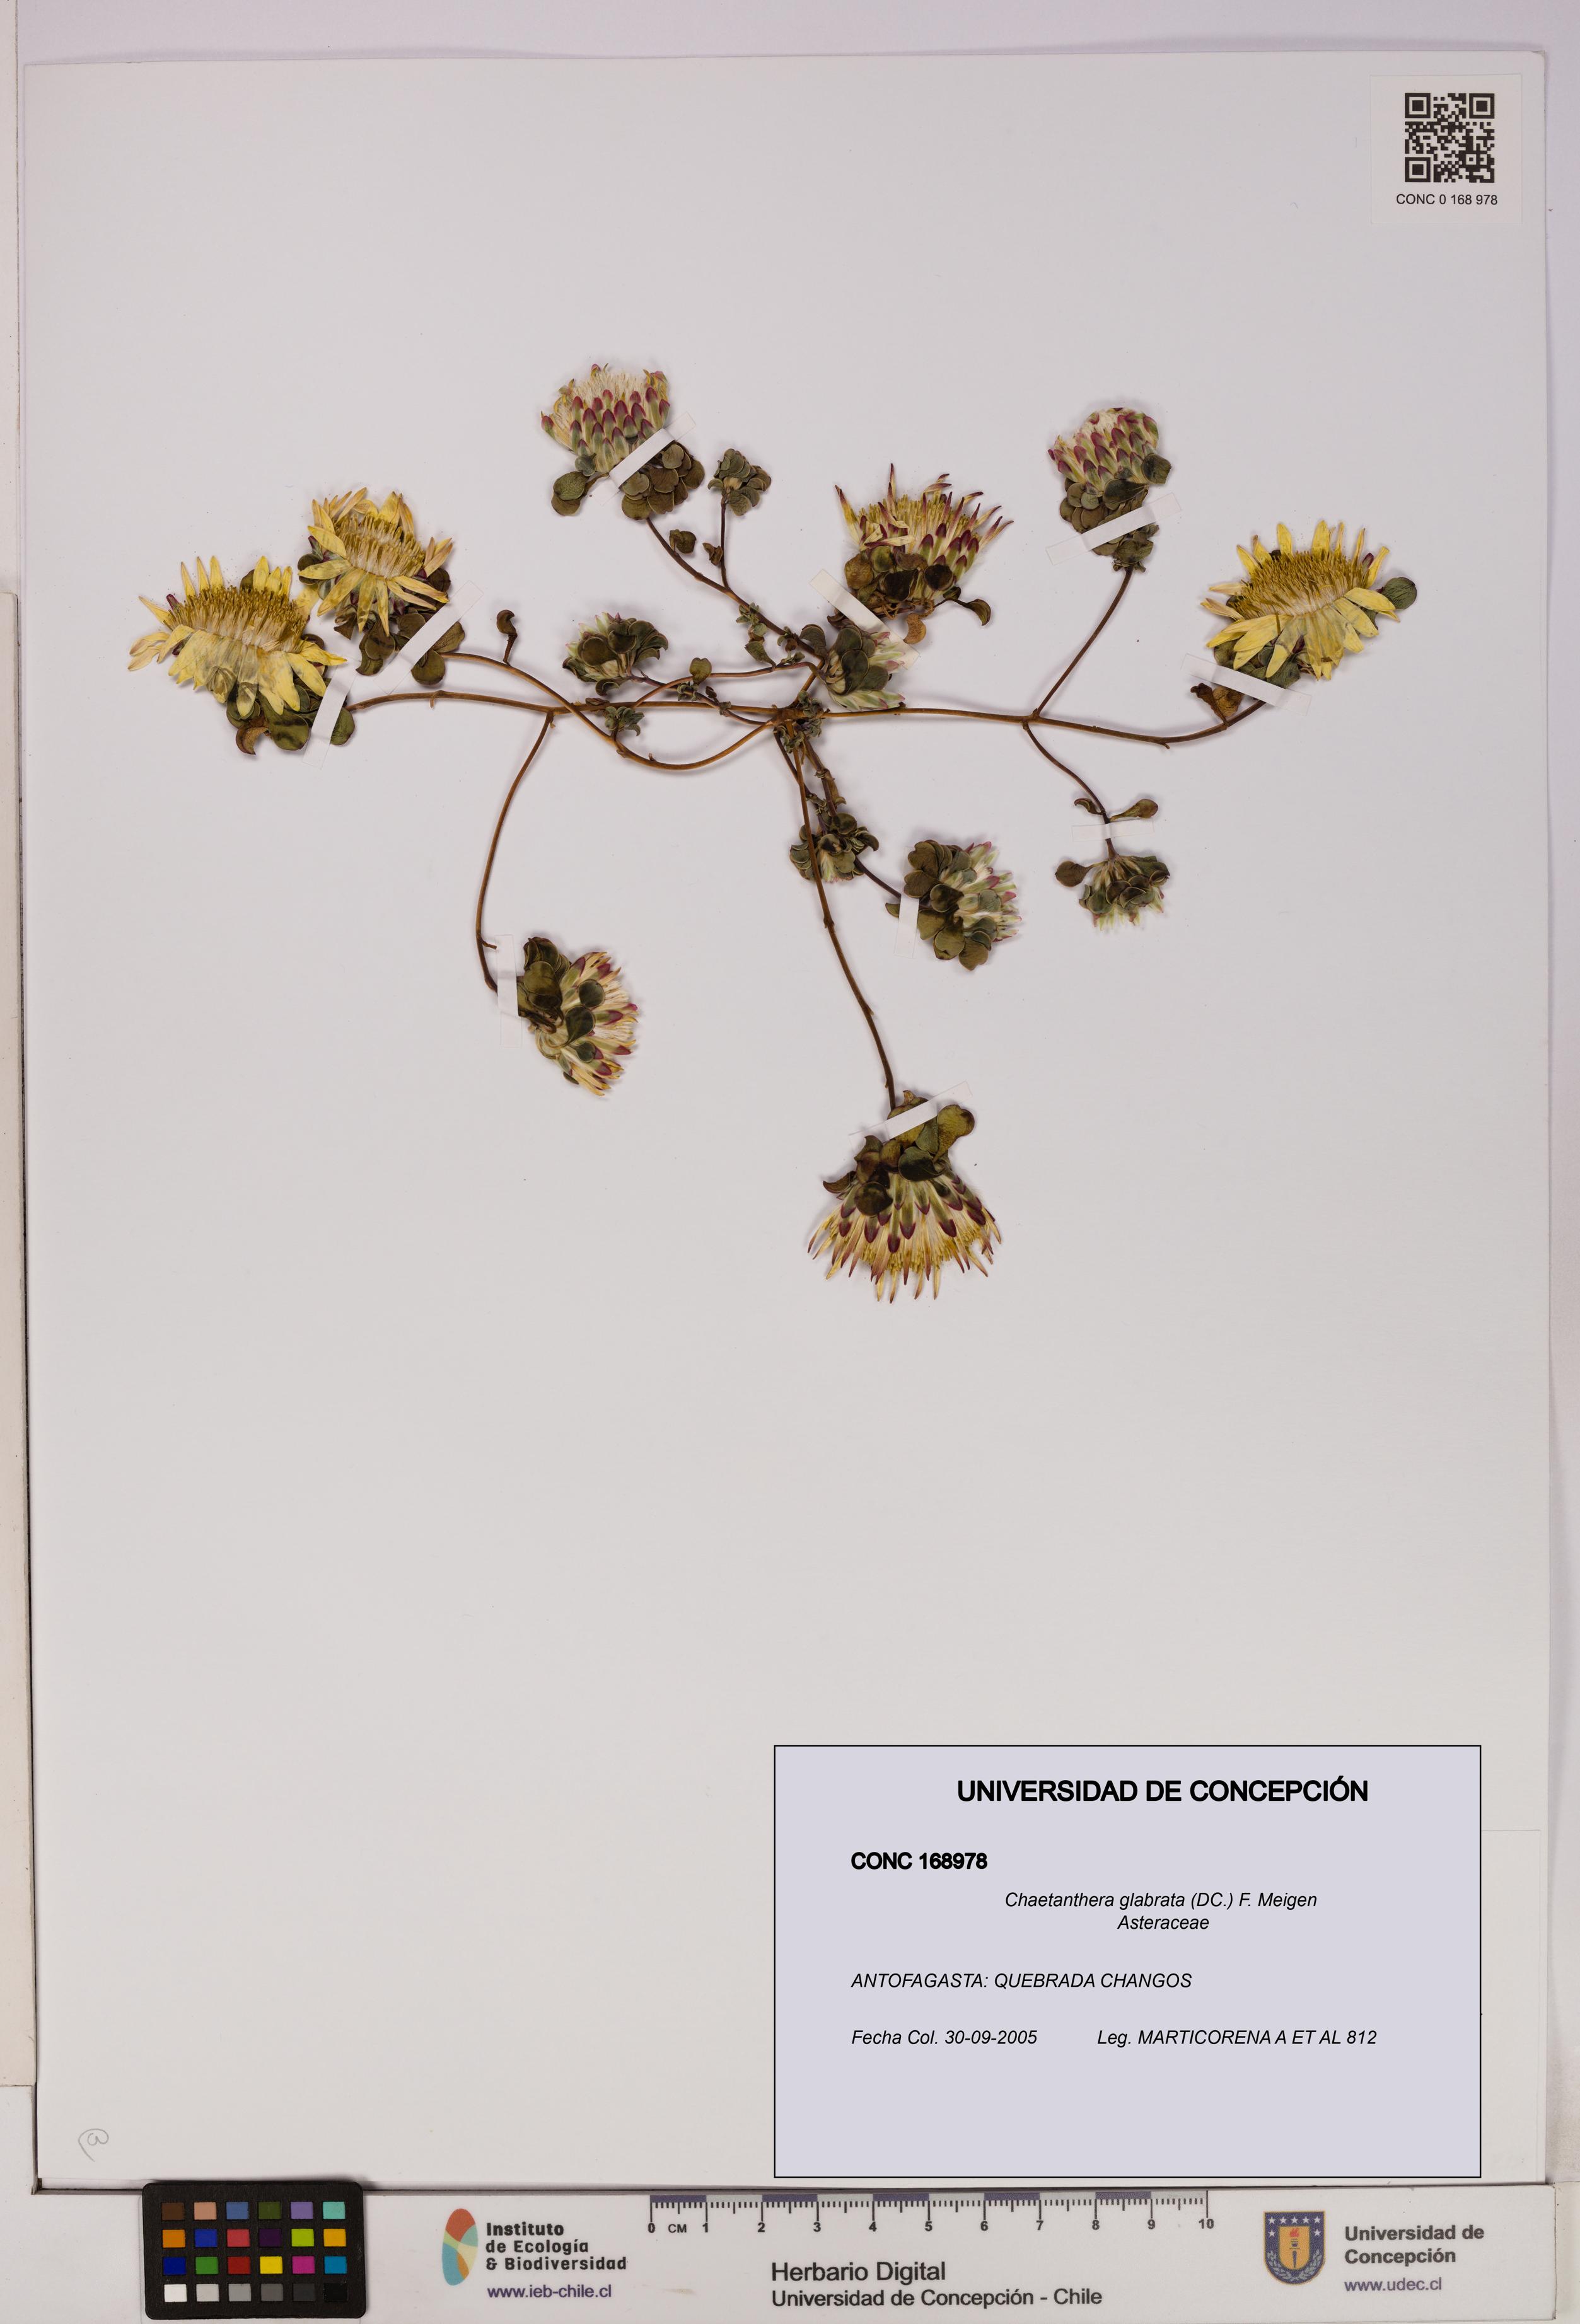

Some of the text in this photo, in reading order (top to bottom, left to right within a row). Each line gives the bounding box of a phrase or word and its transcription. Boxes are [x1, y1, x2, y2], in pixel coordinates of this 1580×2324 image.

[1396, 194, 1498, 205] CONC 0 168 978
[486, 2221, 564, 2236] Instituto
[648, 2218, 1214, 2234] 0 CM 1 2 3 4 5 6 7 8 9 10
[1345, 2224, 1485, 2241] Universidad de
[485, 2239, 589, 2255] de Ecología
[485, 2257, 627, 2270] & Biodiversidad
[1344, 2248, 1456, 2267] Concepción
[772, 2261, 946, 2286] Herbario Digital
[486, 2284, 612, 2298] www.ieb-chile.cl
[1344, 2276, 1442, 2292] www.udec.cl
[772, 2289, 885, 2307] Universidad
[890, 2289, 915, 2306] de
[921, 2288, 1034, 2310] Concepción
[1054, 2287, 1103, 2305] Chile
